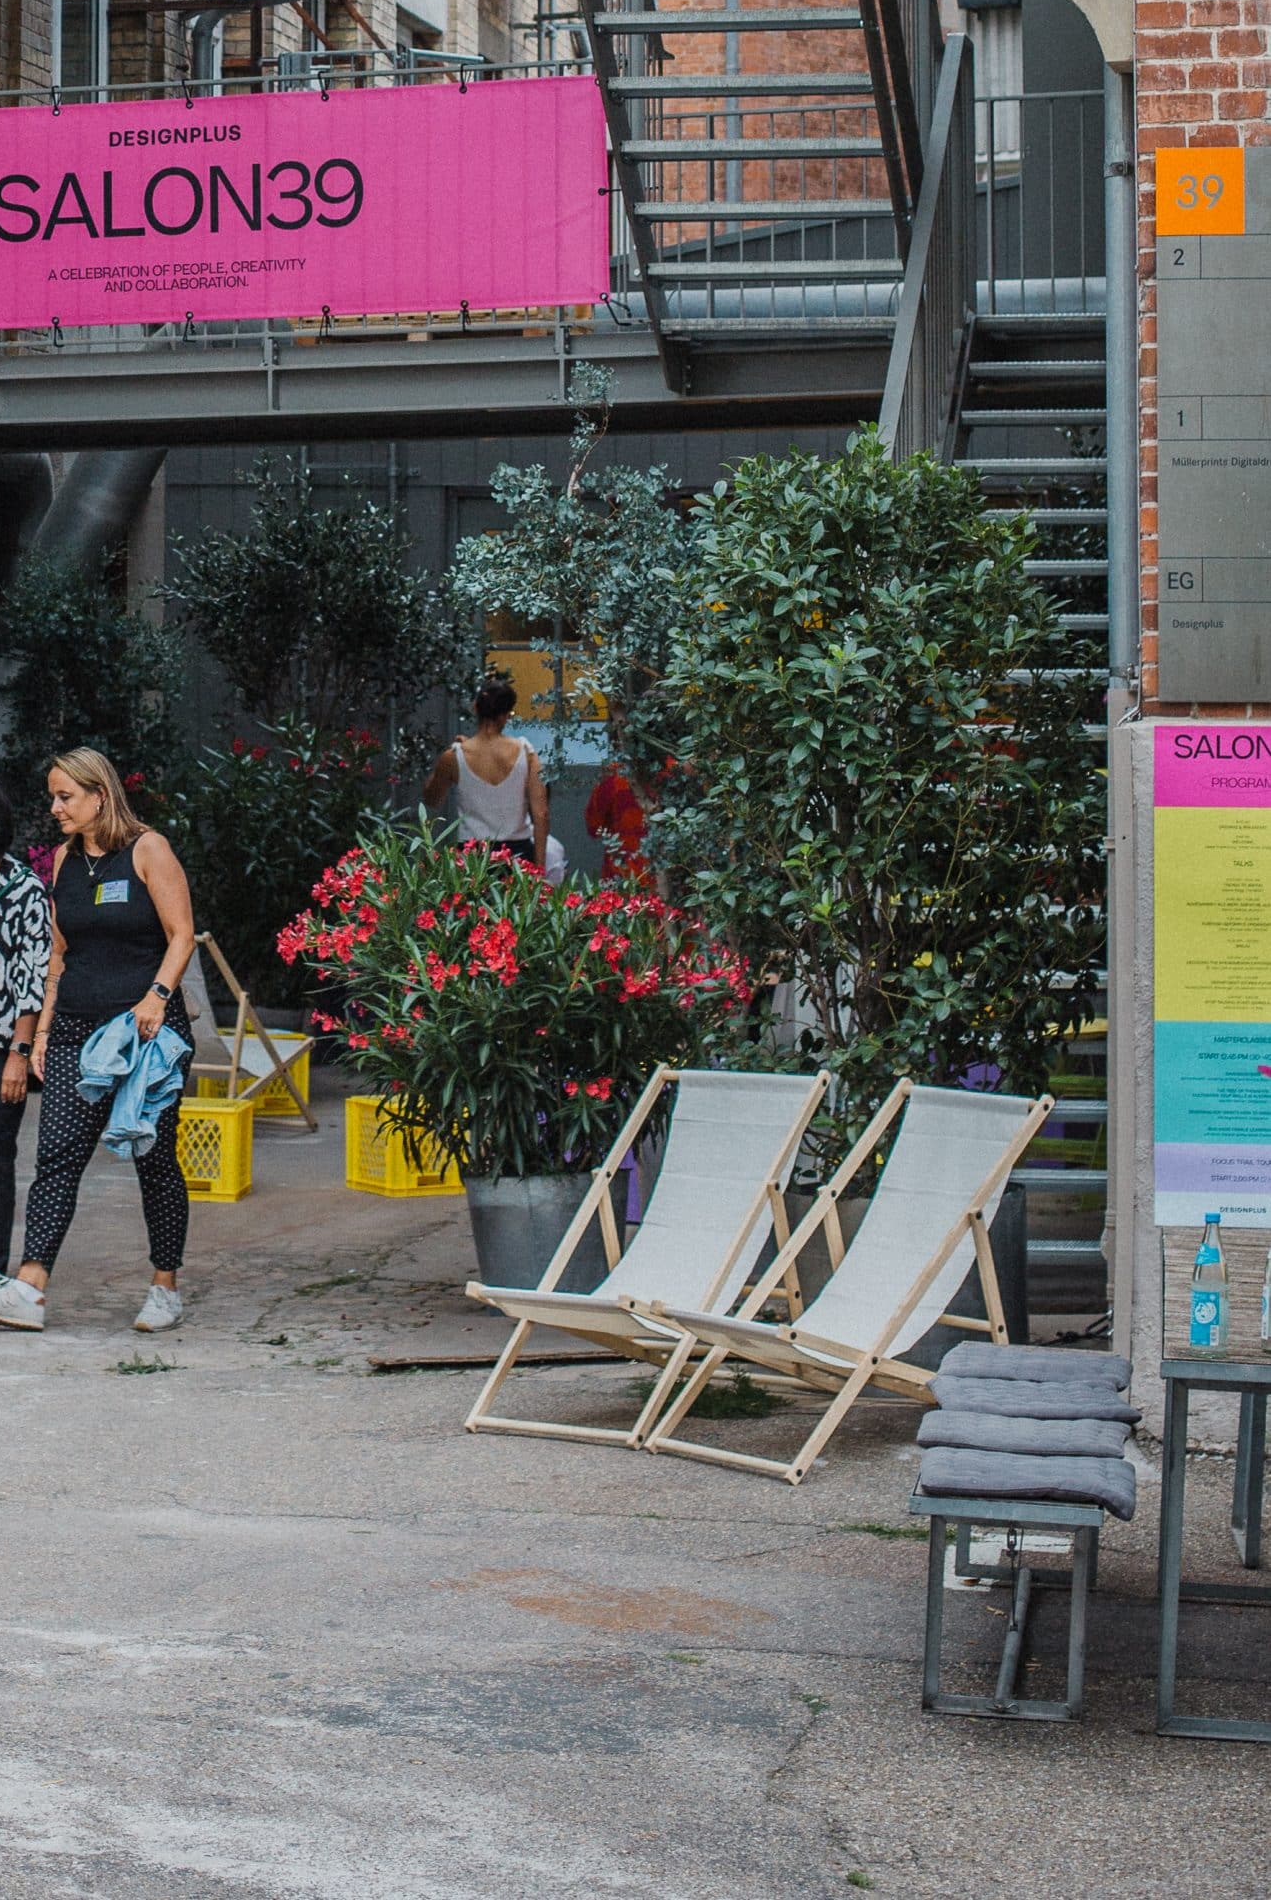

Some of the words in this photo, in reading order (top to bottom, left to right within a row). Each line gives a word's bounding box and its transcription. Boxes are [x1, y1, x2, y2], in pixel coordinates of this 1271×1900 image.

[108, 124, 242, 147] DESIGNPLUS
[1177, 174, 1225, 210] 39
[1173, 248, 1185, 266] 2
[47, 269, 58, 281] A
[59, 265, 150, 281] CELEBRATION
[152, 263, 172, 277] OF
[173, 260, 228, 276] PEOPLE,
[230, 257, 307, 273] CREATIVITY
[103, 279, 132, 293] AND
[135, 276, 249, 291] COLLABORATION.
[1176, 409, 1184, 427] 1
[1171, 456, 1228, 469] Müllerprints
[1231, 456, 1271, 469] Digitaldr
[1168, 571, 1194, 590] EG
[1172, 618, 1225, 630] Designplus
[1211, 1174, 1232, 1182] START
[1219, 1206, 1267, 1214] DESIGNPLUS
